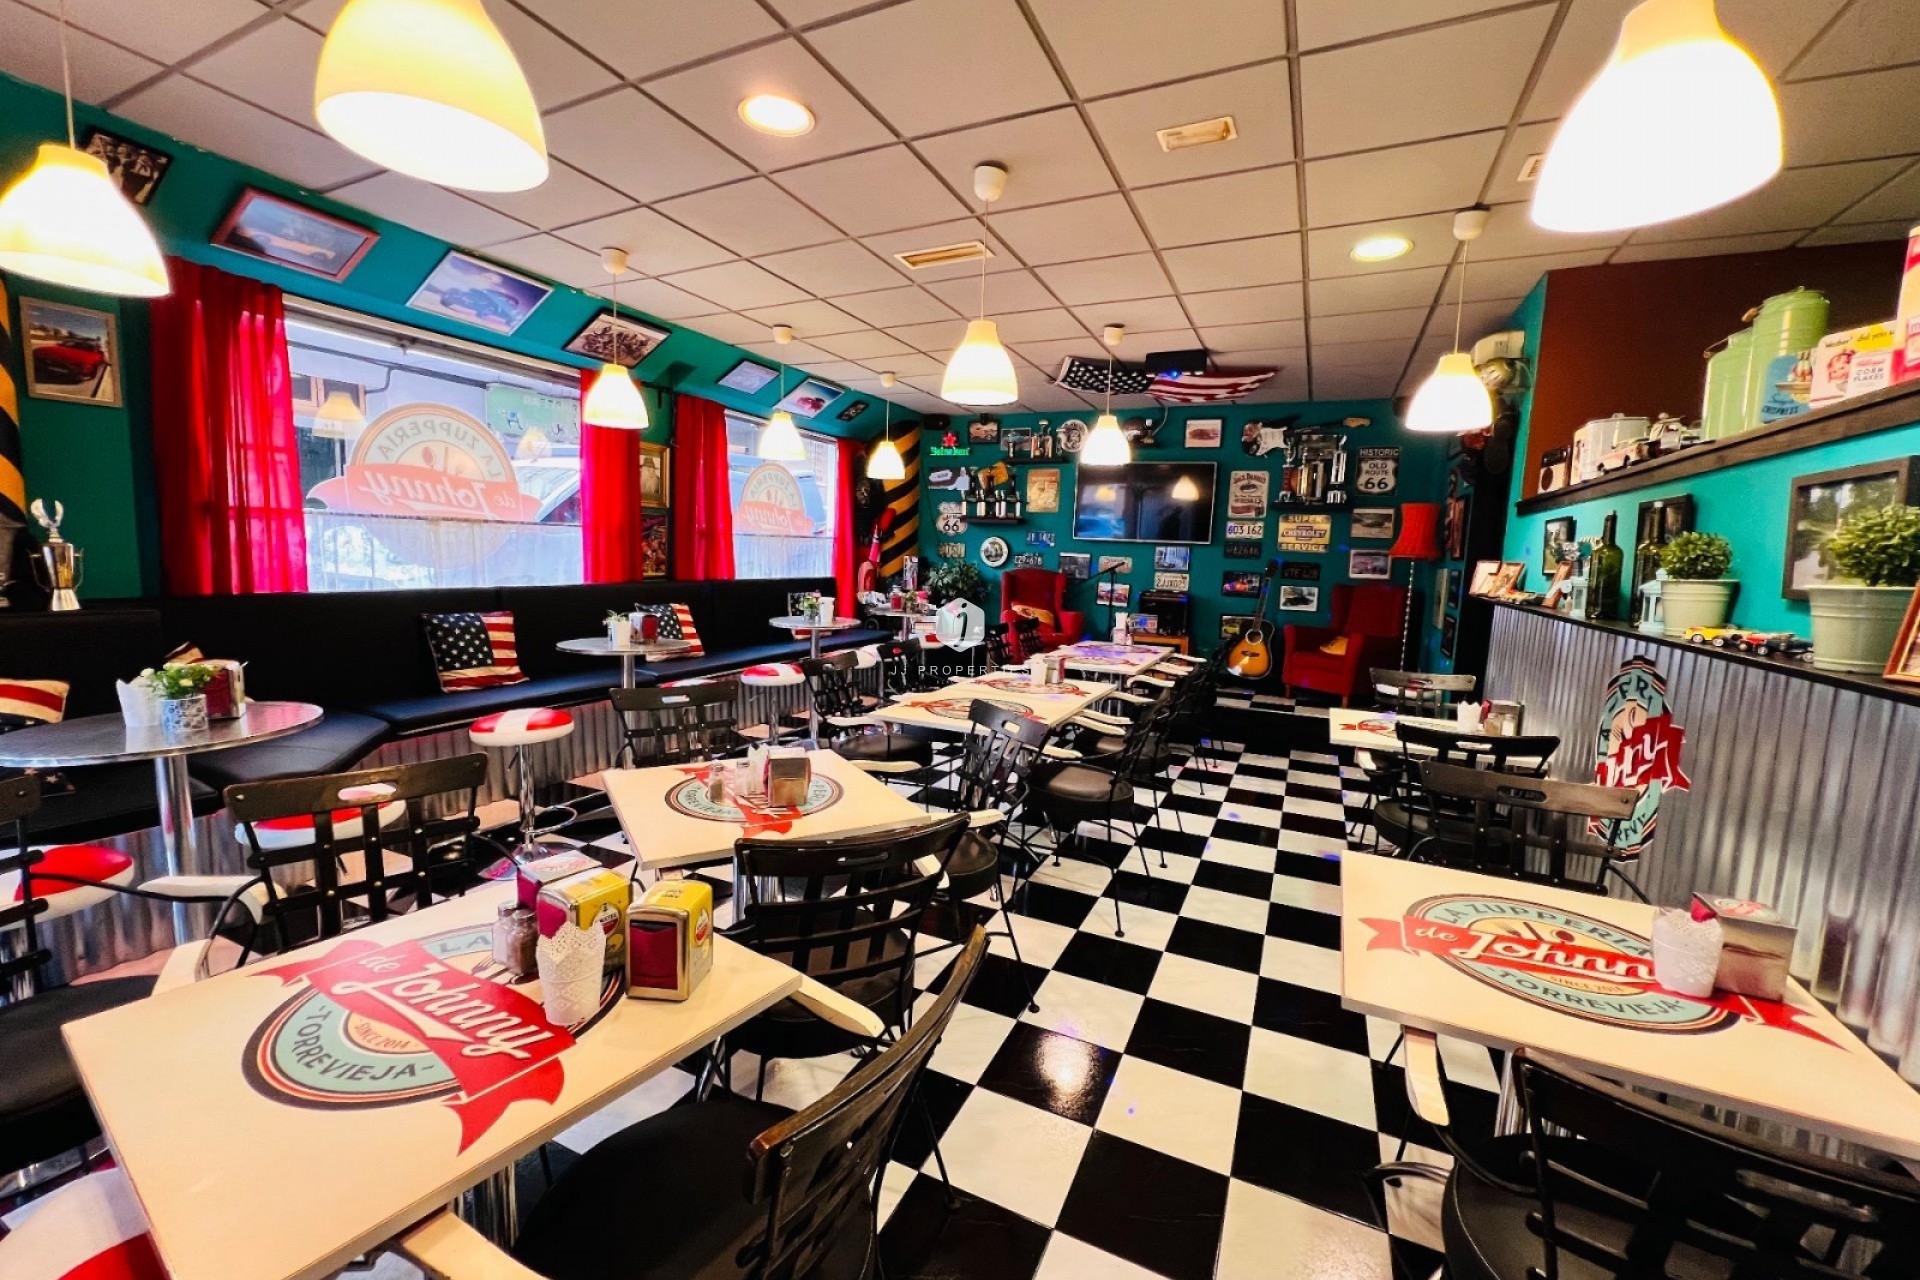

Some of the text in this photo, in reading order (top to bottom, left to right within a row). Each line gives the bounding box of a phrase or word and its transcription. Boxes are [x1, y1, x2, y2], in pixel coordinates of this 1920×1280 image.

[1360, 448, 1399, 456] HISTORIC
[1364, 476, 1388, 490] 66
[942, 519, 960, 532] 66
[1286, 515, 1324, 523] SUPER
[1283, 529, 1327, 538] CHEVROLET
[1279, 543, 1326, 551] SERVICE
[1434, 902, 1654, 958] LA ZUPPERIA
[1414, 926, 1656, 984] de Johnn
[330, 952, 555, 1061] de Johnny
[354, 1020, 384, 1047] SINCE
